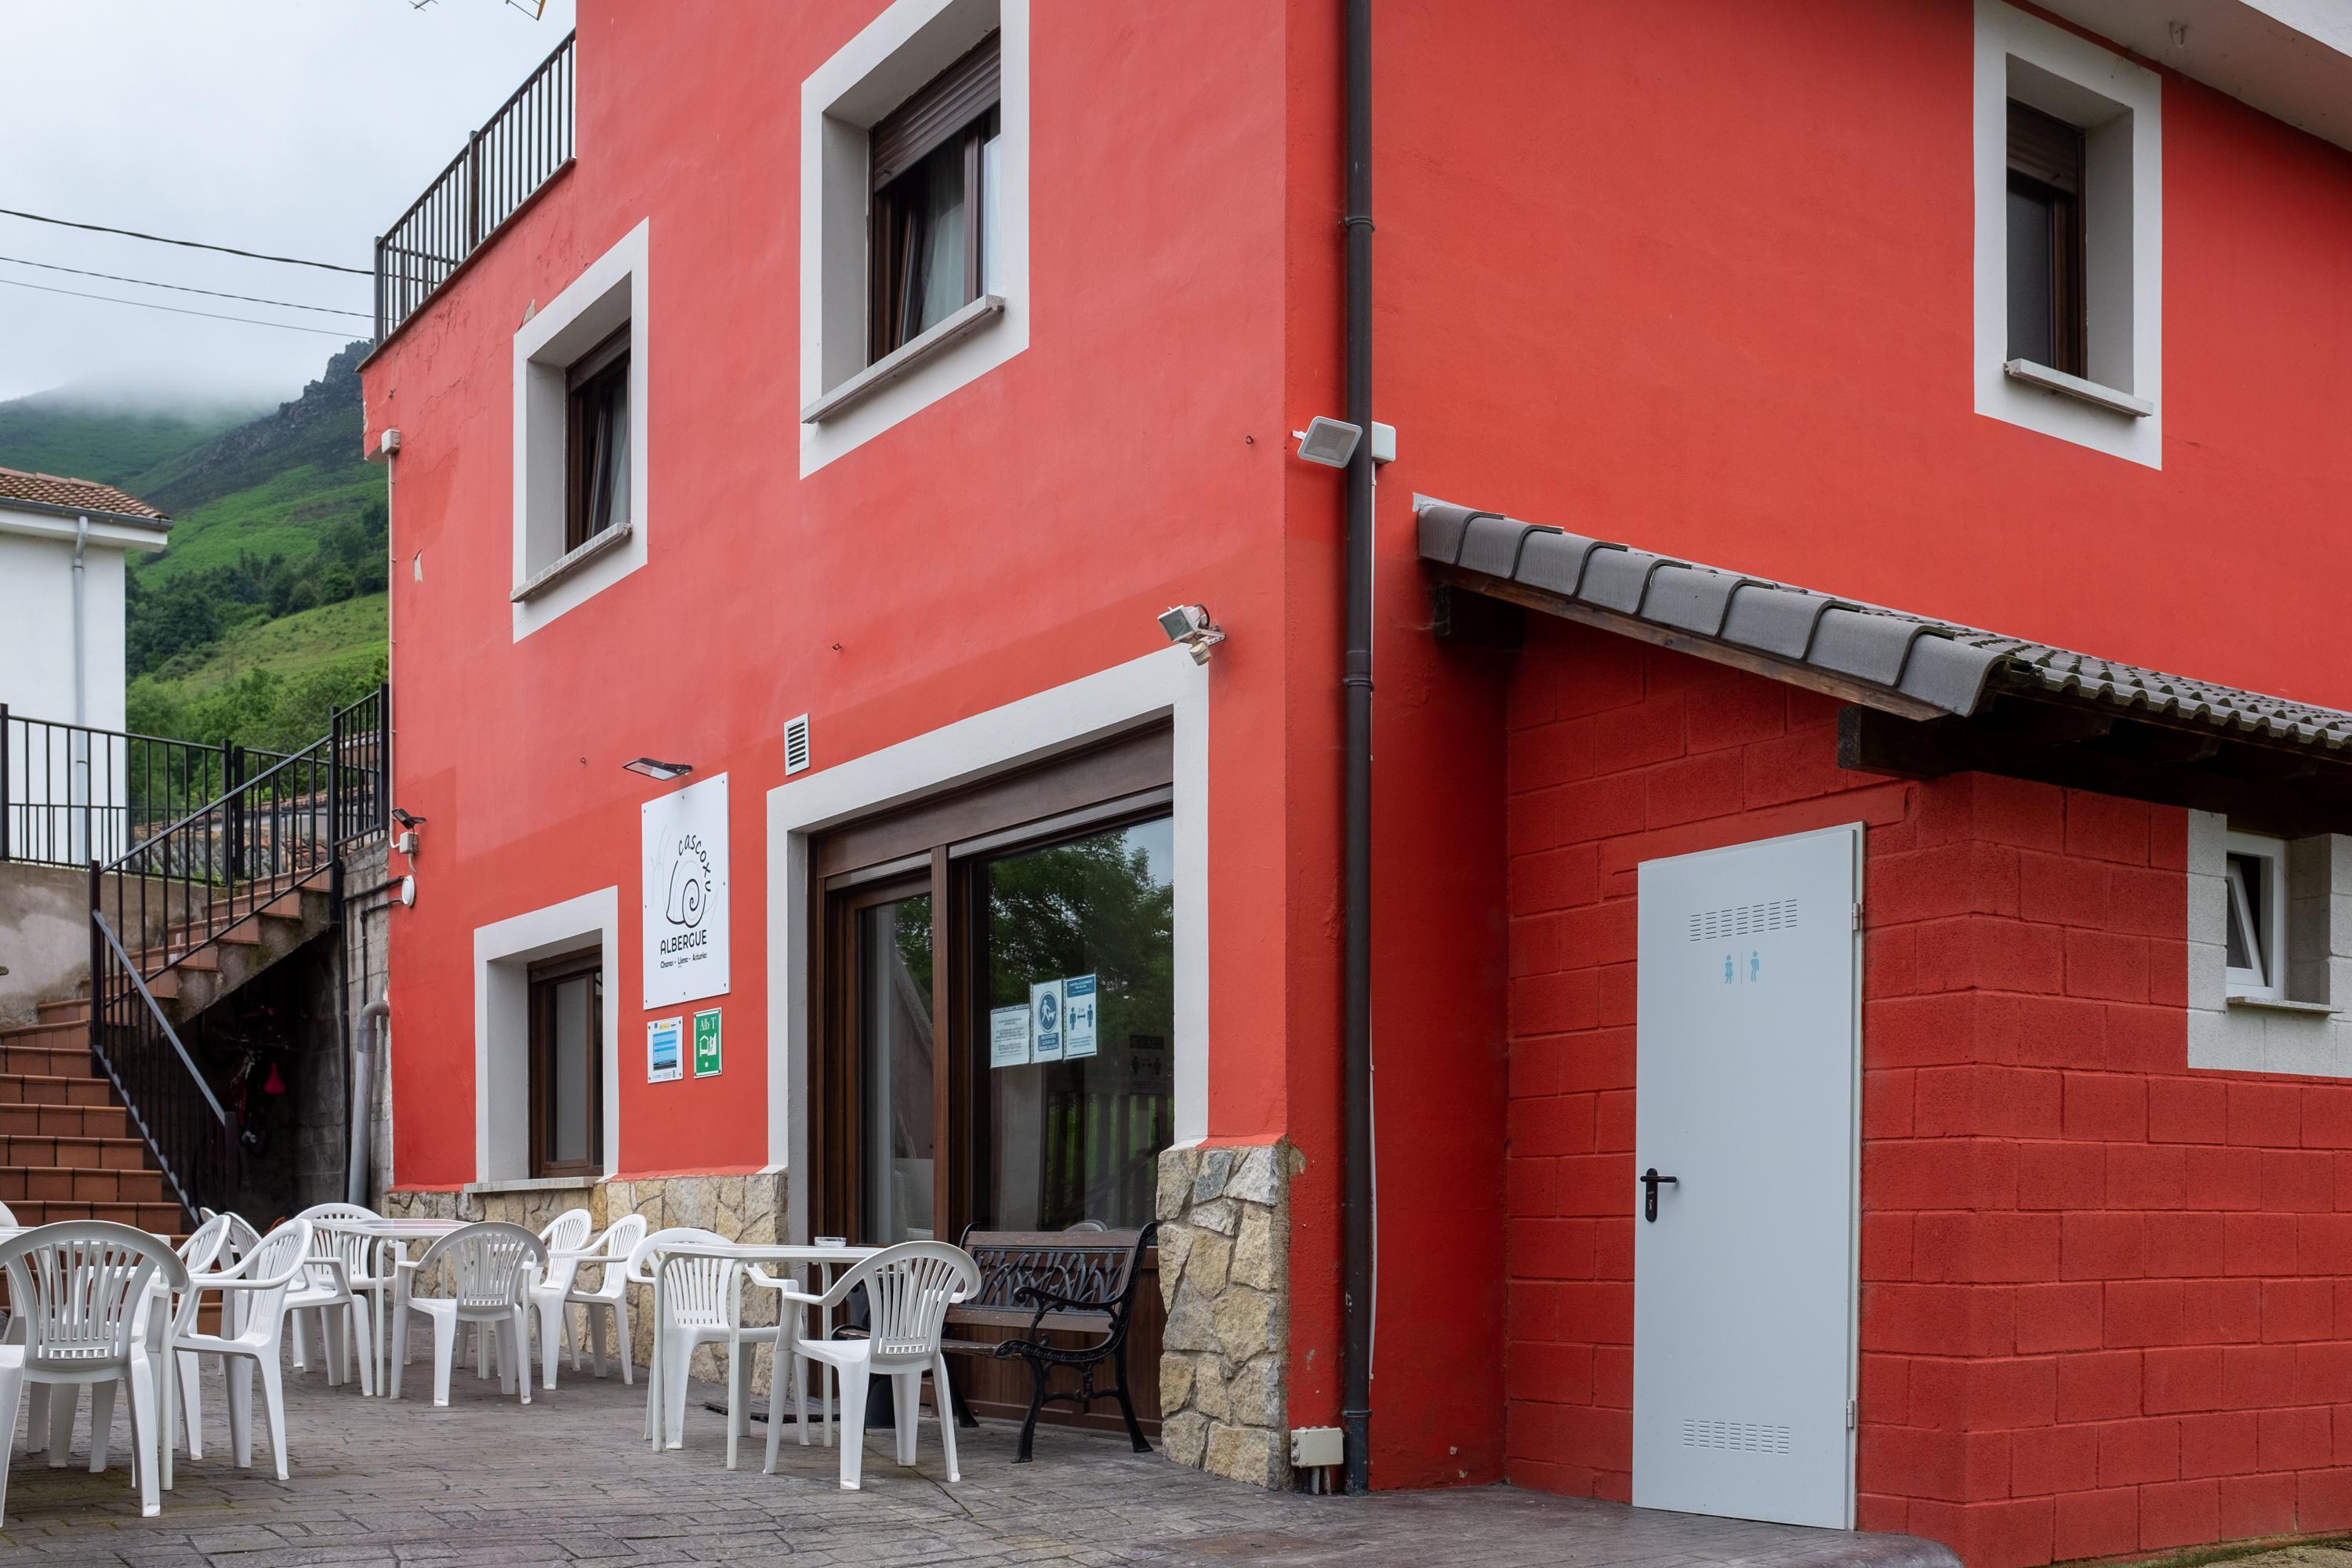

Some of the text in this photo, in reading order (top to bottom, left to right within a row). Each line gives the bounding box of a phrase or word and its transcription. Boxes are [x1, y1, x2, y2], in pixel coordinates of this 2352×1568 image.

[660, 929, 707, 956] ALBERGUE
[699, 1016, 717, 1031] Alb T
